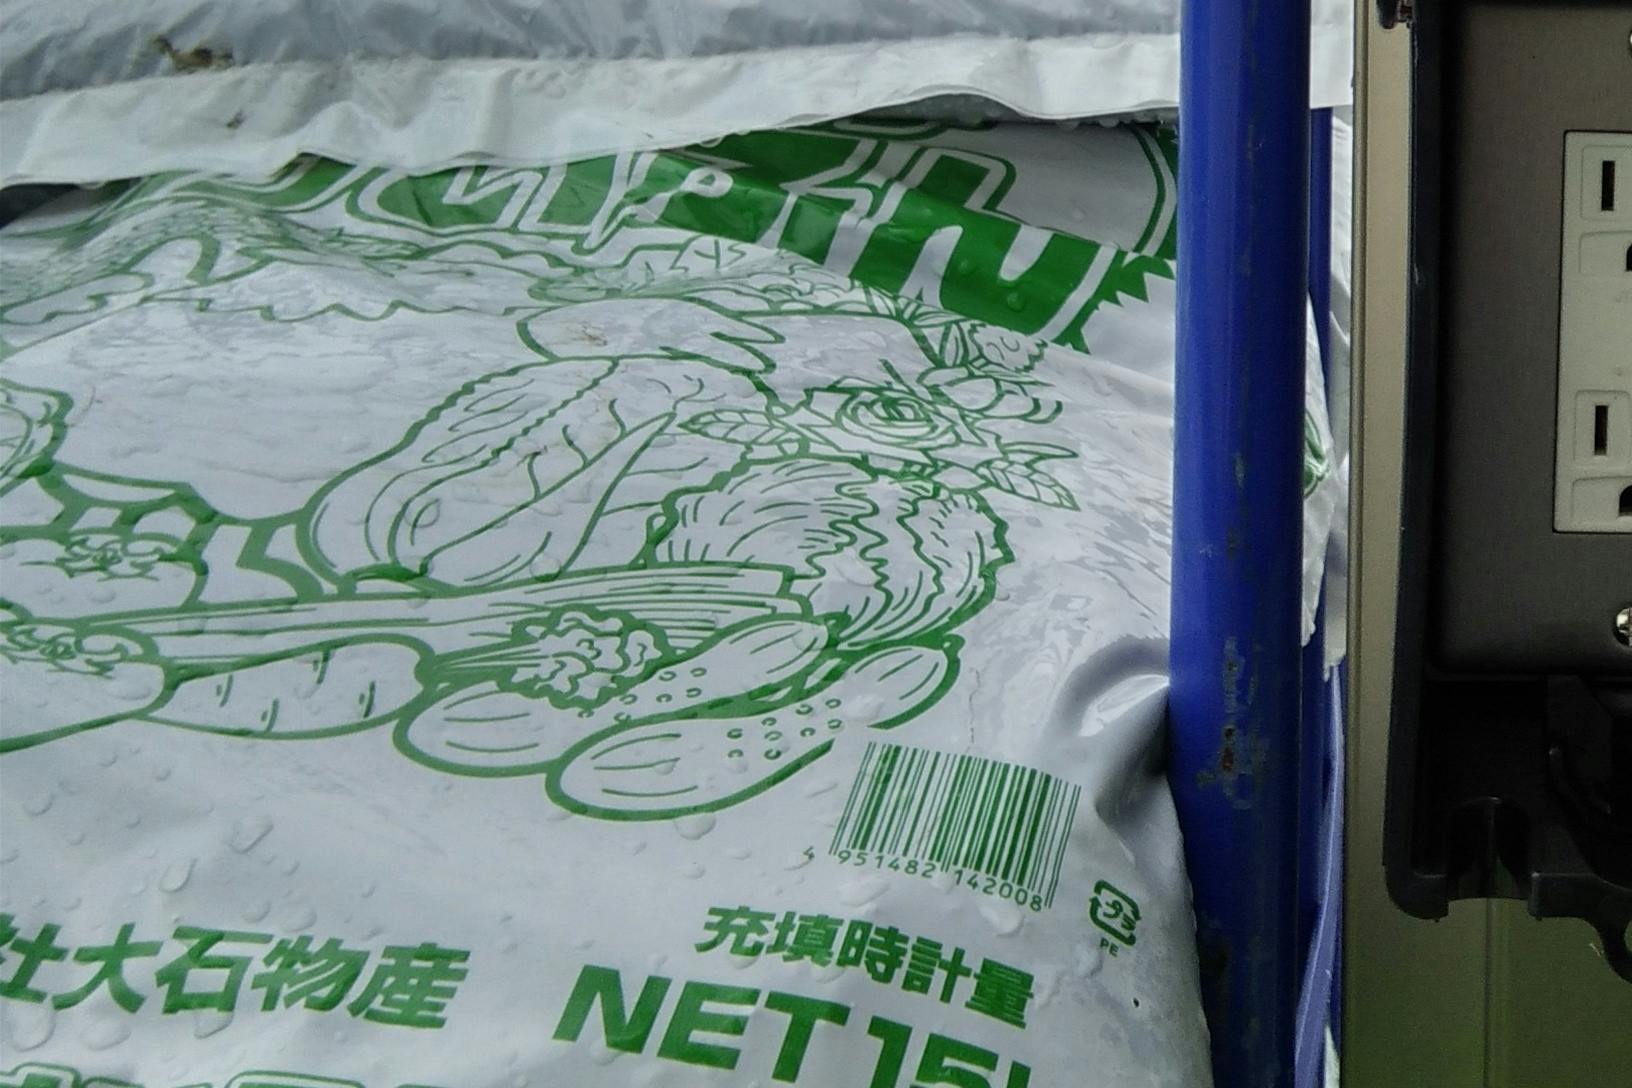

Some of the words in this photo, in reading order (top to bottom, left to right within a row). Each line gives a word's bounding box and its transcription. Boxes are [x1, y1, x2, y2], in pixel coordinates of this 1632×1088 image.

[803, 846, 815, 861] 4
[837, 849, 937, 879] 951482
[953, 868, 1043, 913] 142008
[694, 904, 1036, 1029] 充填時計量
[1100, 936, 1120, 958] PE
[552, 963, 851, 1084] NET
[867, 1014, 1032, 1088] 15
